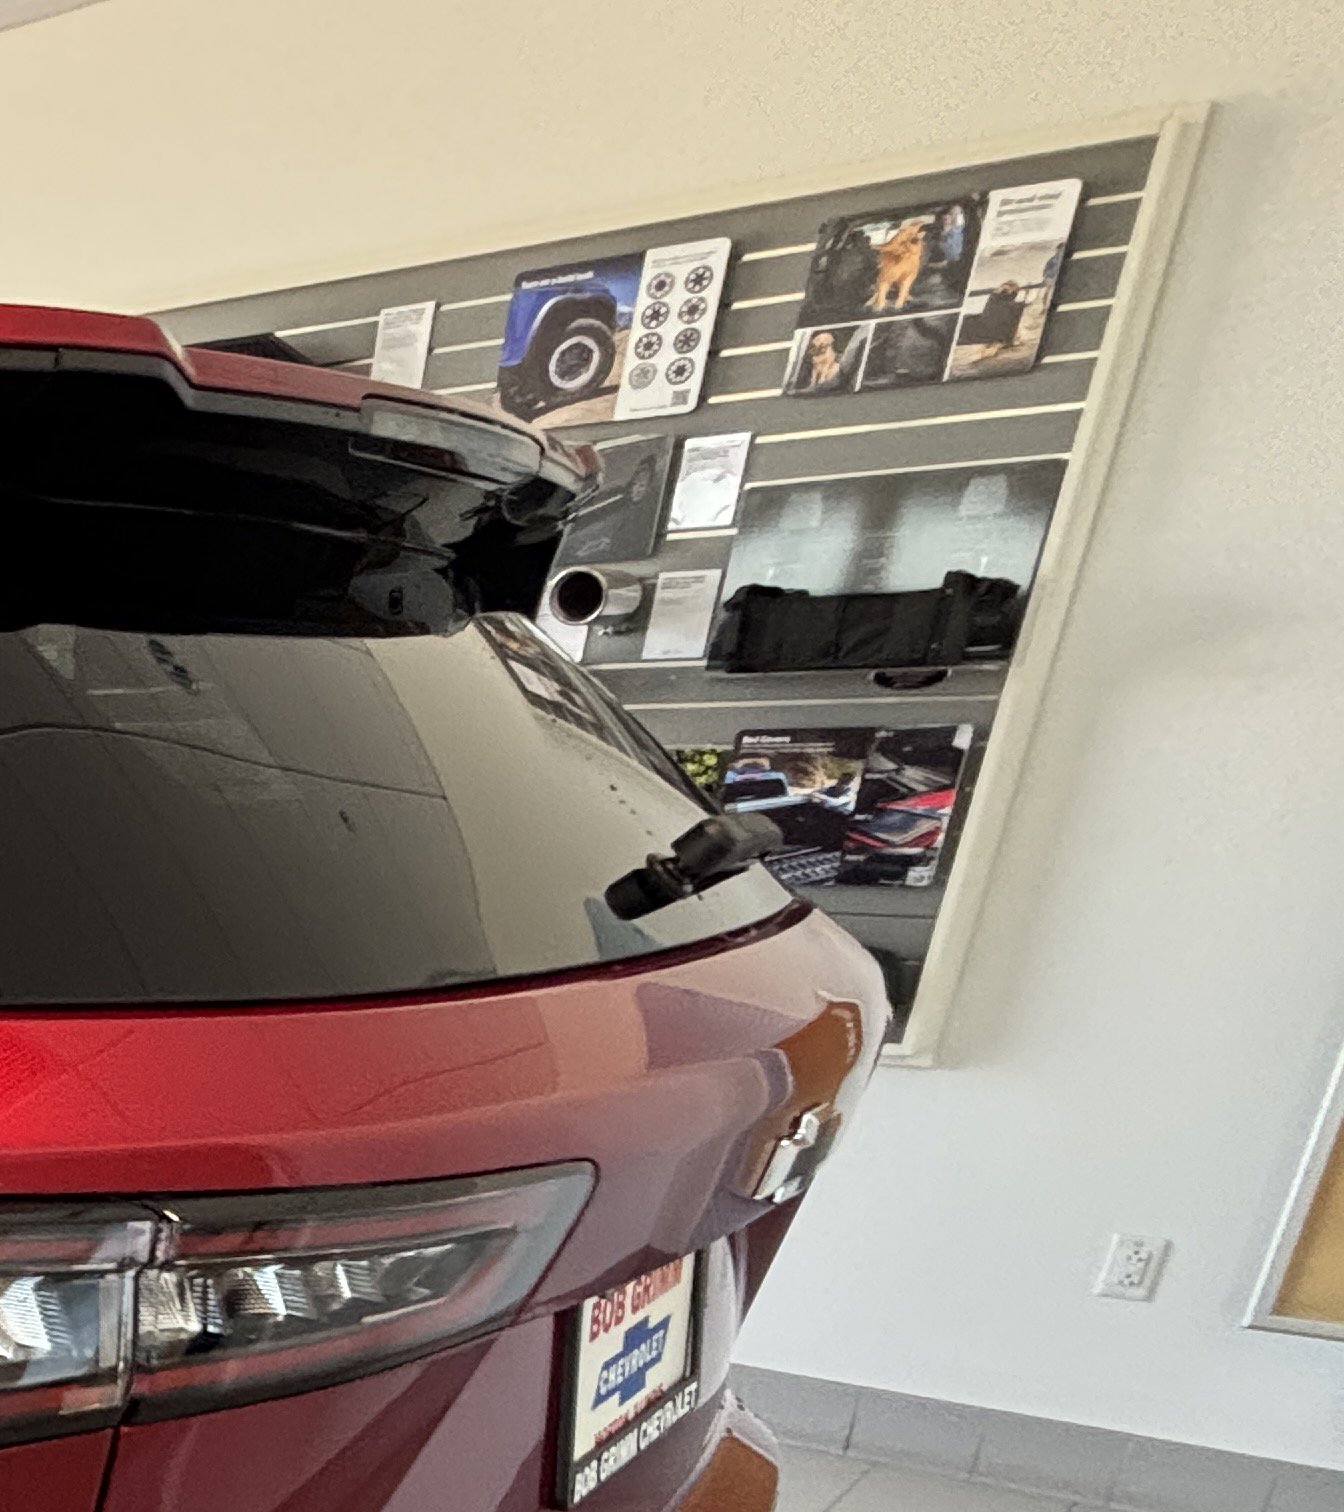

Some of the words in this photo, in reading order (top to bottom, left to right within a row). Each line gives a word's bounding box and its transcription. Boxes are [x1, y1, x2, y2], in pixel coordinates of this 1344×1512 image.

[589, 1290, 626, 1342] BOB
[599, 1330, 664, 1395] CHEVROLET
[573, 1460, 598, 1505] BOB
[638, 1381, 699, 1450] CHEVROLET
